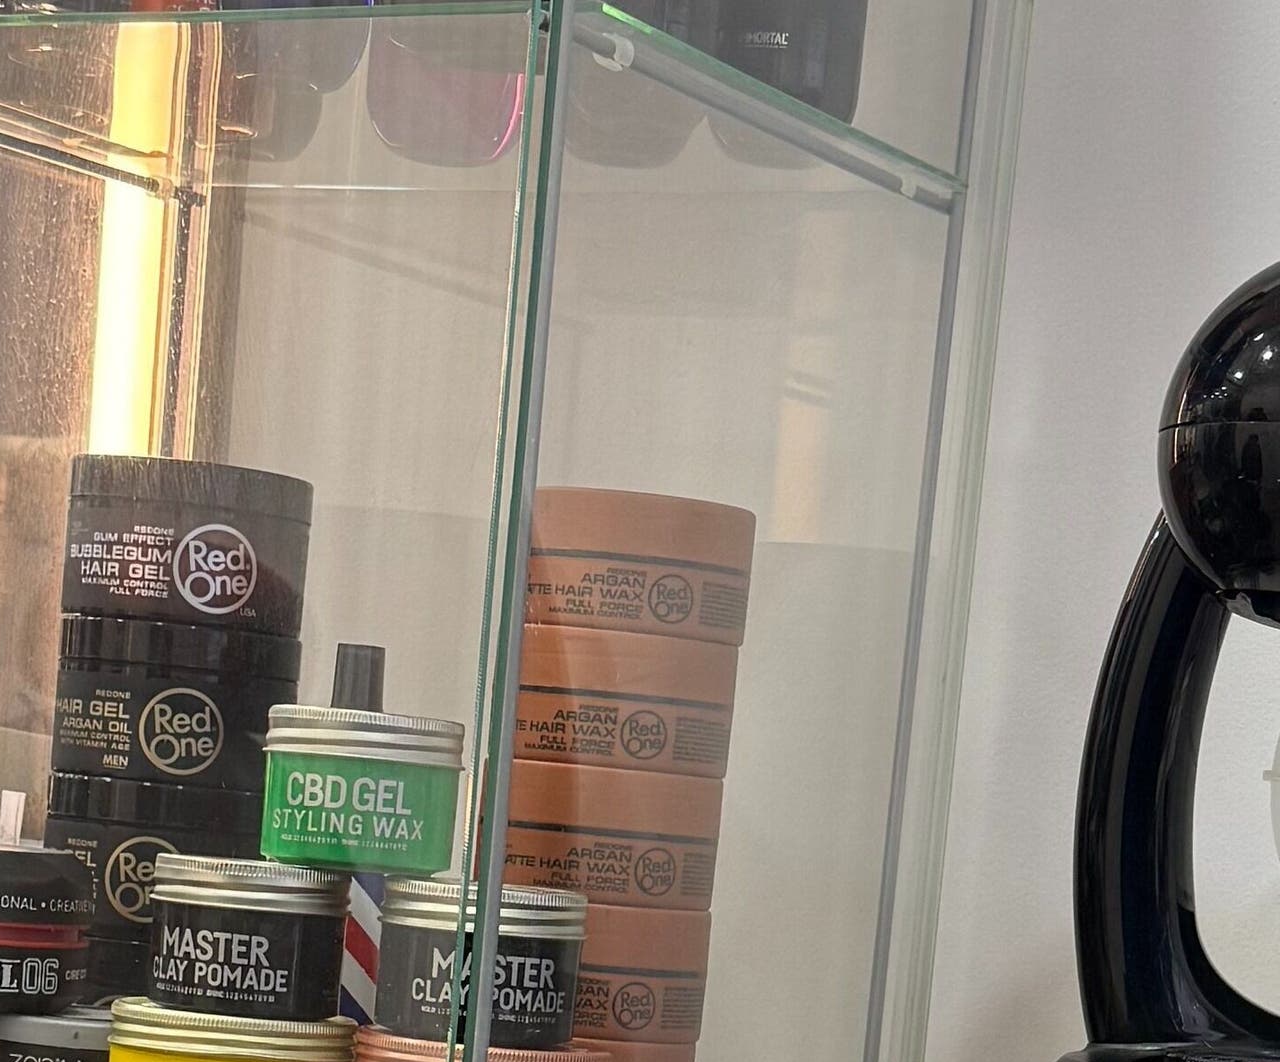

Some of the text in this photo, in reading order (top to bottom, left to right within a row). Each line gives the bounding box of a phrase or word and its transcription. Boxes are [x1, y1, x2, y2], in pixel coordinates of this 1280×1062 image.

[94, 532, 118, 541] GUM
[70, 544, 172, 564] BUBBLEGUM
[81, 561, 170, 581] HAIR GEL
[185, 571, 248, 603] One
[581, 573, 646, 589] ARGAN
[554, 584, 593, 598] HAIR
[600, 587, 644, 602] WAX
[566, 598, 644, 613] FULL FORCE
[56, 698, 130, 719] HAIR GEL
[553, 709, 617, 726] ARGAN
[62, 716, 132, 734] ARGAN OIL
[154, 704, 211, 734] Red
[629, 719, 662, 737] Red
[529, 721, 566, 734] HAIR
[571, 724, 616, 740] WAX
[539, 734, 567, 746] FULL
[150, 734, 214, 765] One
[102, 754, 129, 767] MEN
[286, 771, 412, 815] CBD GEL
[272, 808, 424, 841] STYLING WAX
[566, 847, 632, 863] ARGAN
[120, 852, 156, 883] Re
[539, 857, 580, 870] HAIR
[586, 860, 630, 876] WAX
[163, 925, 269, 967] MASTER
[22, 957, 59, 994] 06
[153, 956, 188, 982] CLAY
[194, 961, 288, 992] POMADE
